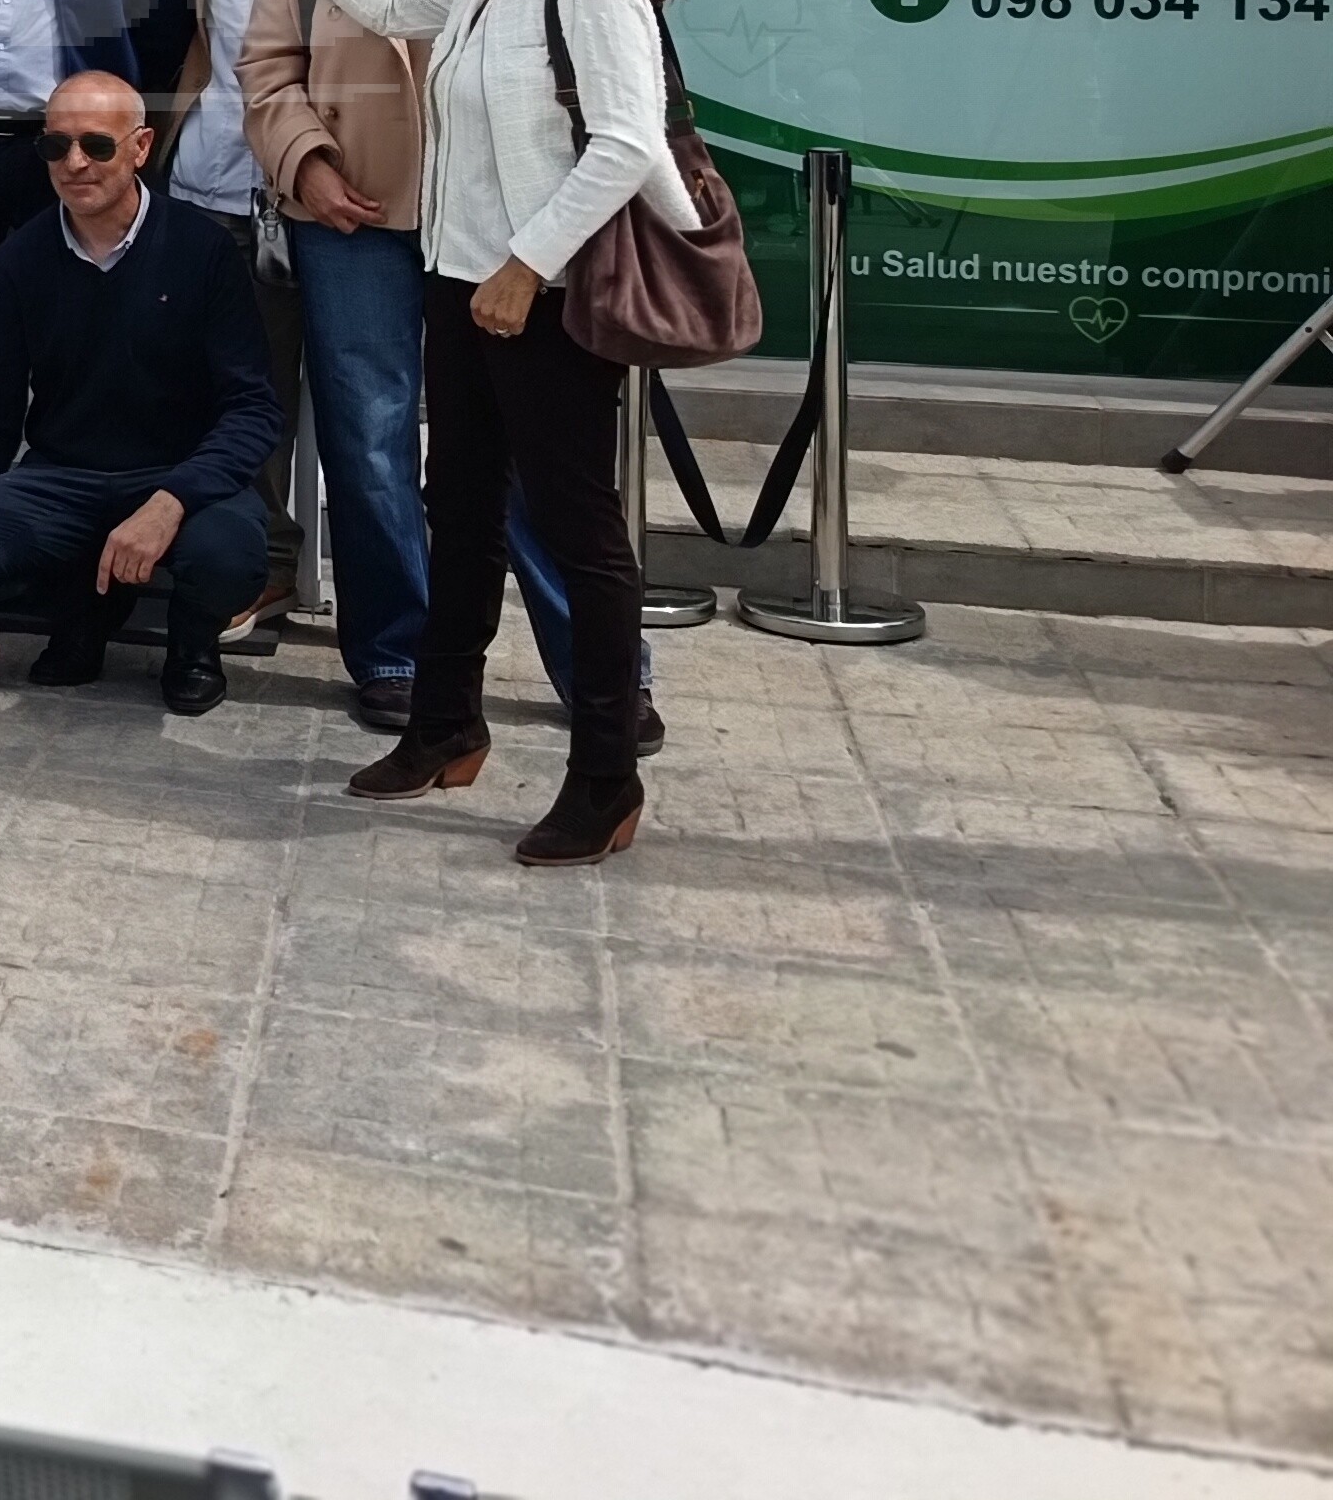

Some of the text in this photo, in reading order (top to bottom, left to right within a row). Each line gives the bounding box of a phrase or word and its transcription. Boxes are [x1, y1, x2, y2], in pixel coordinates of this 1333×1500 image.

[881, 250, 980, 280] Salud
[992, 258, 1129, 286] nuestro
[1141, 266, 1331, 297] compromi
